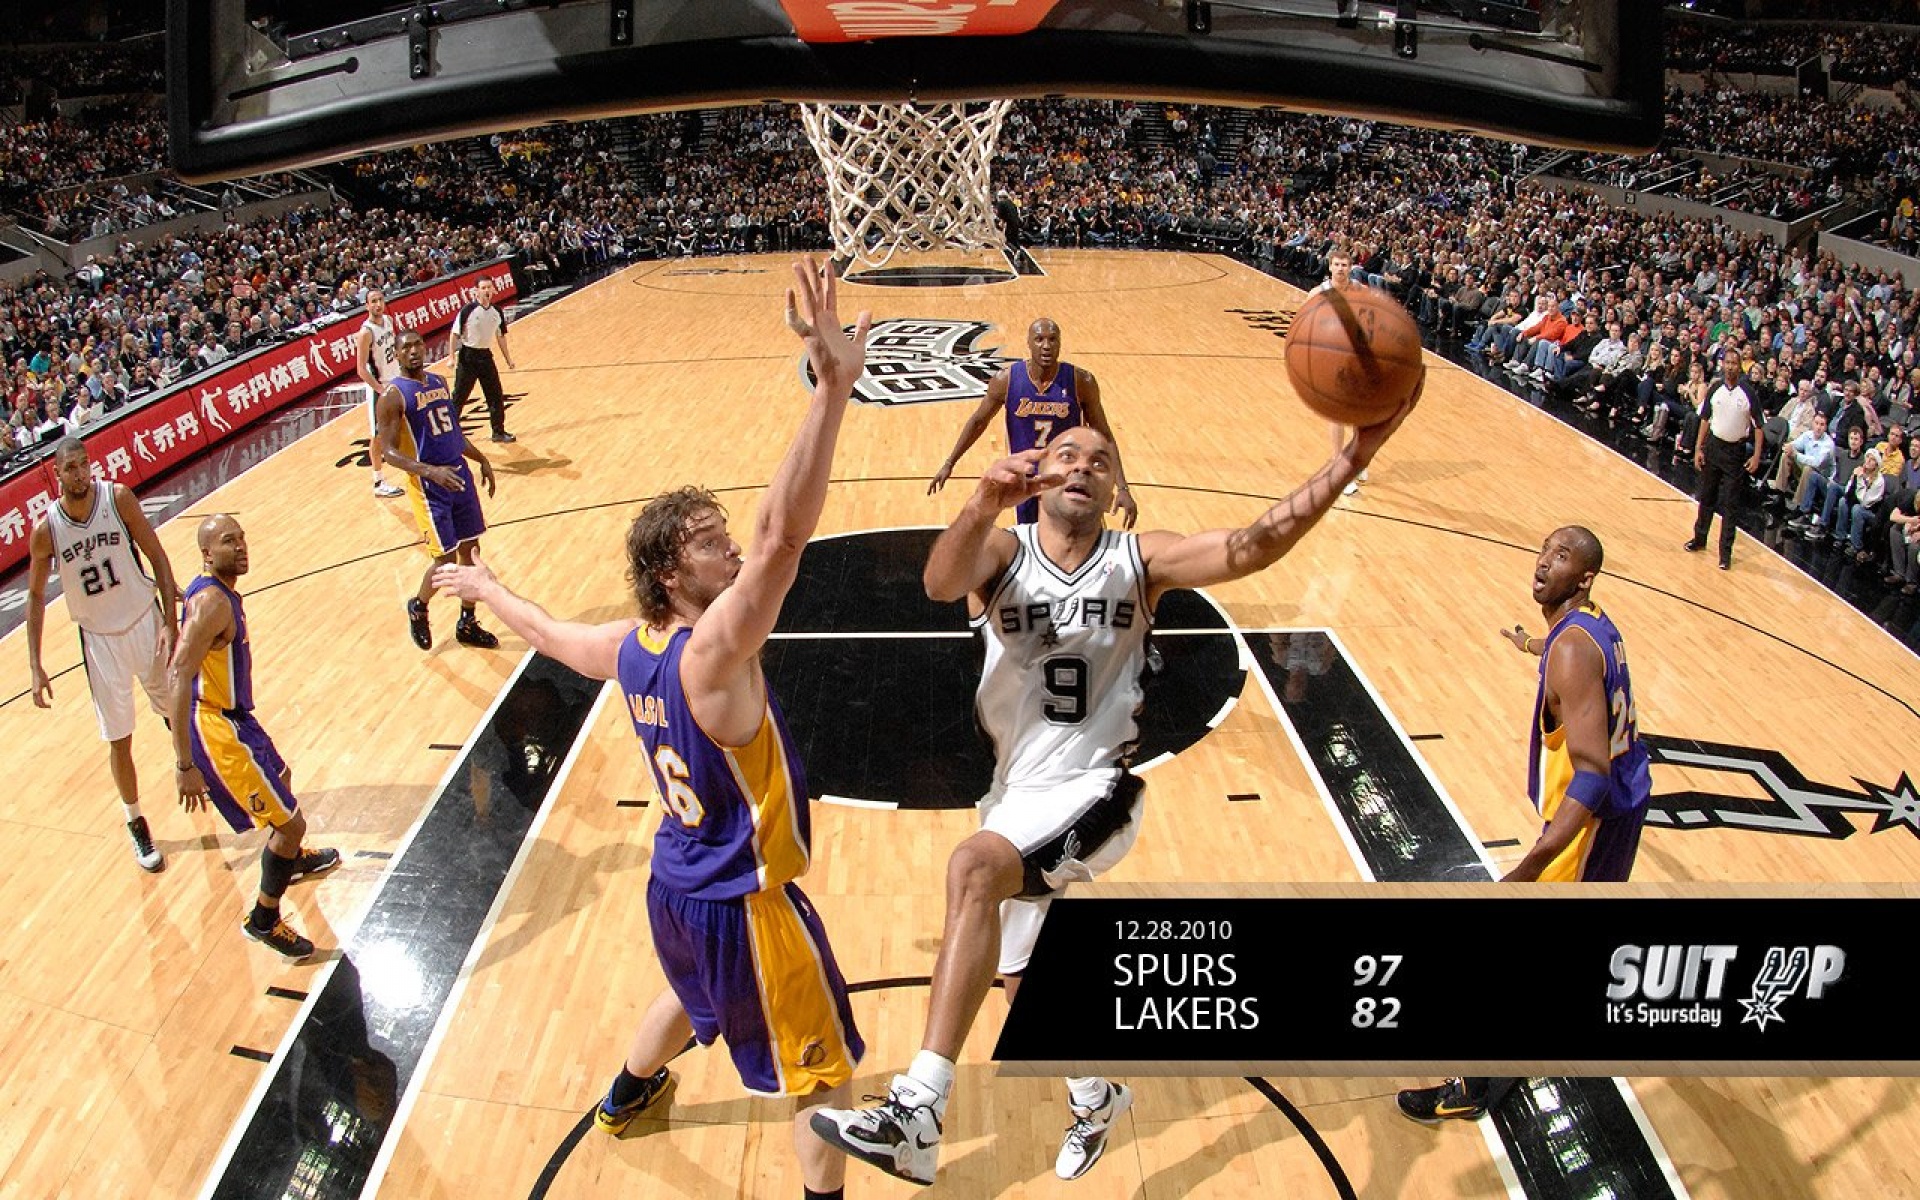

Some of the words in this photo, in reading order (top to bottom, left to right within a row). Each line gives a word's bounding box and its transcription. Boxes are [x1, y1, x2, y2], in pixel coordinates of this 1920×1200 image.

[227, 355, 310, 414] 乔丹体育
[427, 405, 453, 436] 15
[1014, 397, 1069, 418] LAKERS
[152, 410, 199, 453] 乔丹
[1034, 419, 1053, 448] 7
[62, 532, 120, 562] SPURS
[81, 558, 120, 596] 21
[1001, 598, 1134, 646] SPURS
[1041, 654, 1092, 726] 9
